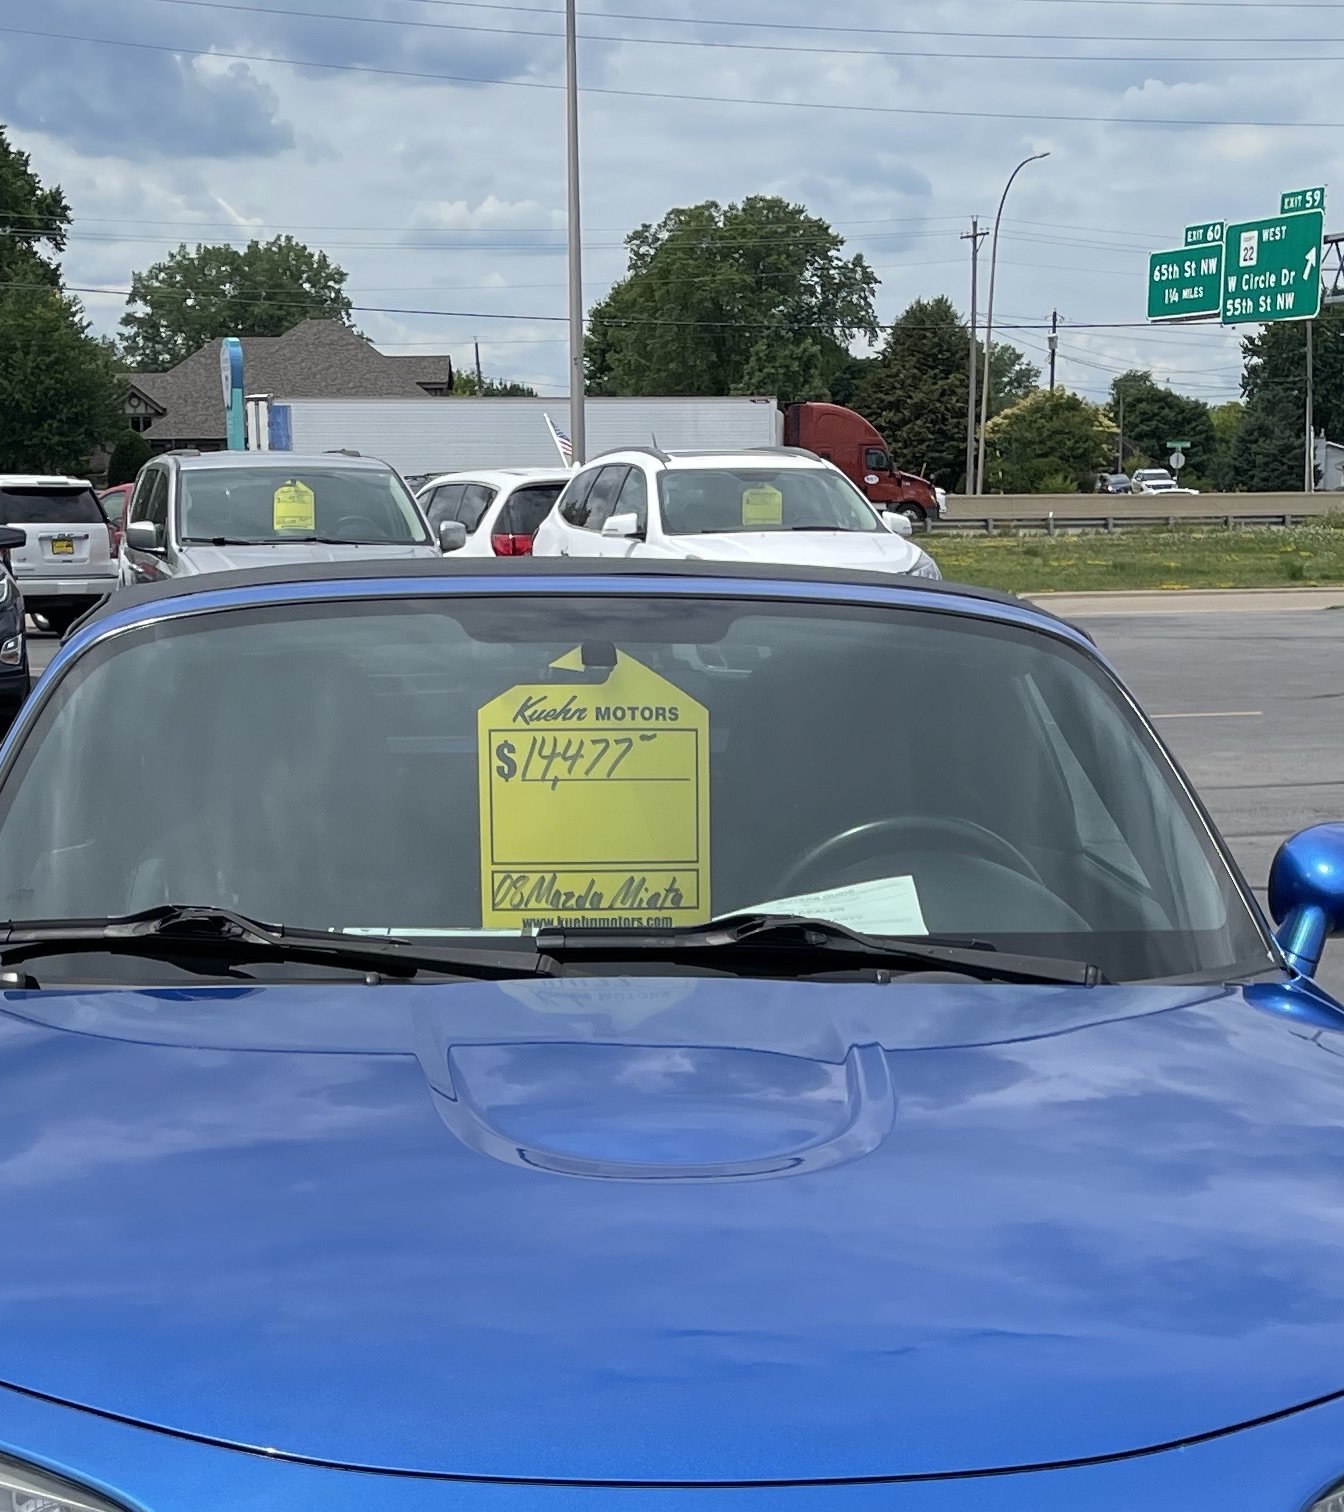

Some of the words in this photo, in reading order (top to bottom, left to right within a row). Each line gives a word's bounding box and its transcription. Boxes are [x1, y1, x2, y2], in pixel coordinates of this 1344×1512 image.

[1284, 195, 1302, 209] EXIT
[1306, 190, 1321, 208] 59
[1187, 229, 1203, 242] EXIT
[1207, 224, 1222, 241] 60
[1262, 226, 1287, 242] WEST
[1243, 246, 1254, 262] 22
[1153, 263, 1179, 281] 65th
[1184, 260, 1196, 277] St
[1200, 257, 1218, 275] NW
[1227, 275, 1237, 293] W
[1242, 271, 1276, 291] Circle
[1281, 268, 1295, 286] Dr
[1182, 287, 1204, 299] MILES
[1226, 297, 1253, 316] 55th
[1259, 295, 1271, 313] St
[1276, 292, 1295, 310] NW
[512, 695, 588, 726] Kuehn
[595, 705, 680, 722] MOTORS
[524, 872, 603, 910] Mazda
[608, 875, 684, 912] Miata
[522, 915, 673, 928] wwwkuehnmotorscom
